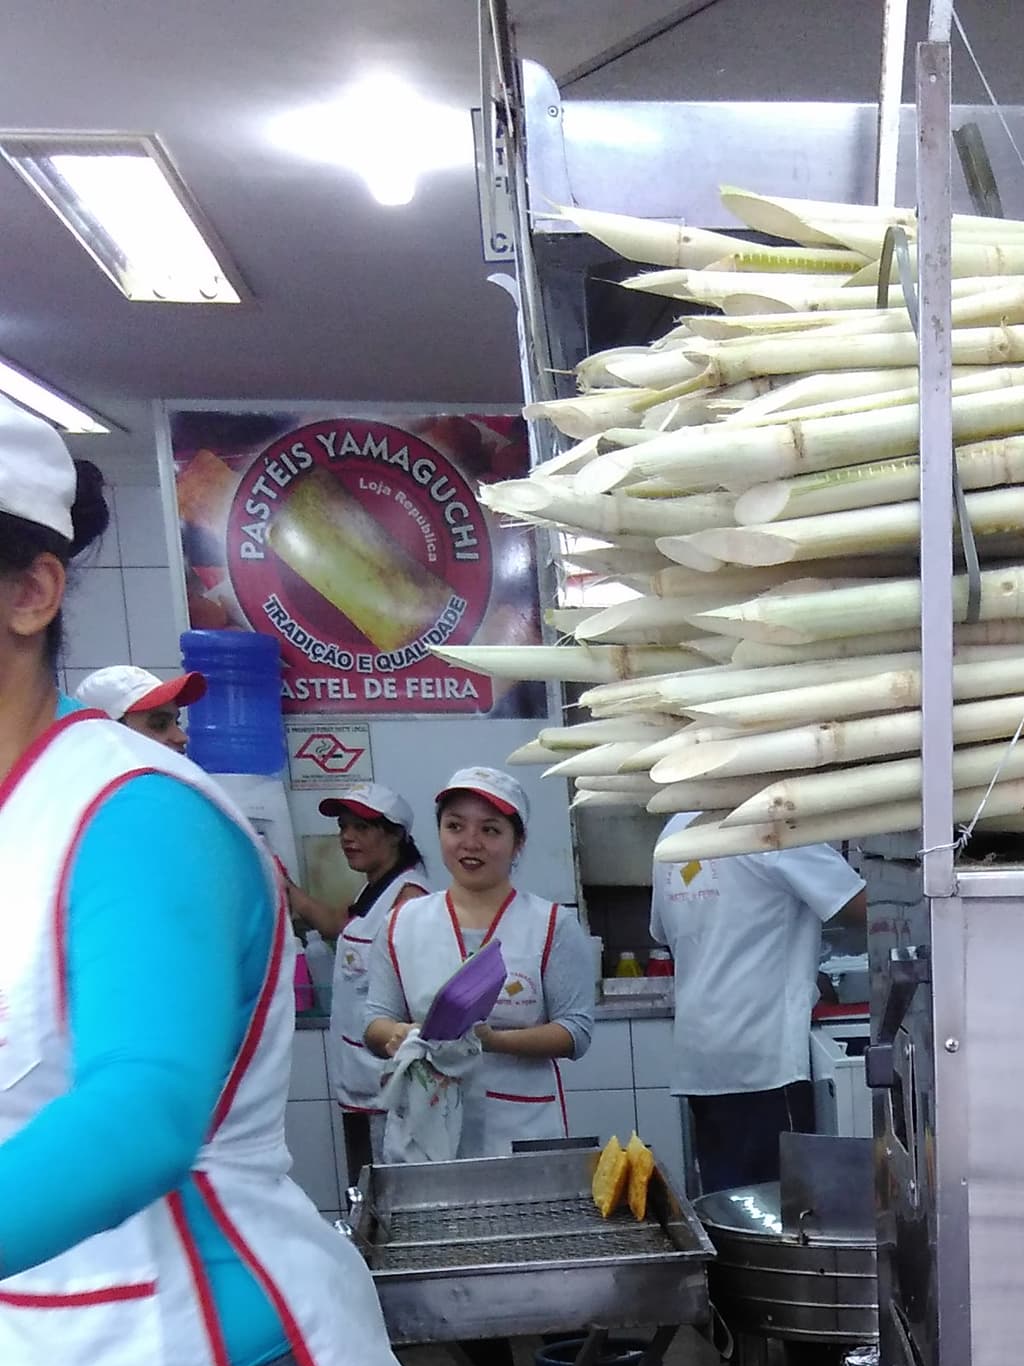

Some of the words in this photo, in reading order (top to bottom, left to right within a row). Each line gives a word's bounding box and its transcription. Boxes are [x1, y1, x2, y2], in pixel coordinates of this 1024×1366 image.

[241, 442, 314, 560] PASTÉIS
[316, 432, 480, 562] YAMAGUCHI
[360, 477, 392, 496] Loja
[263, 594, 353, 670] TRADIÇÃO
[357, 654, 372, 672] E
[376, 596, 466, 671] QUALIDADE
[280, 678, 357, 699] ASTEL
[364, 678, 398, 699] DE
[406, 678, 479, 699] FEIRA
